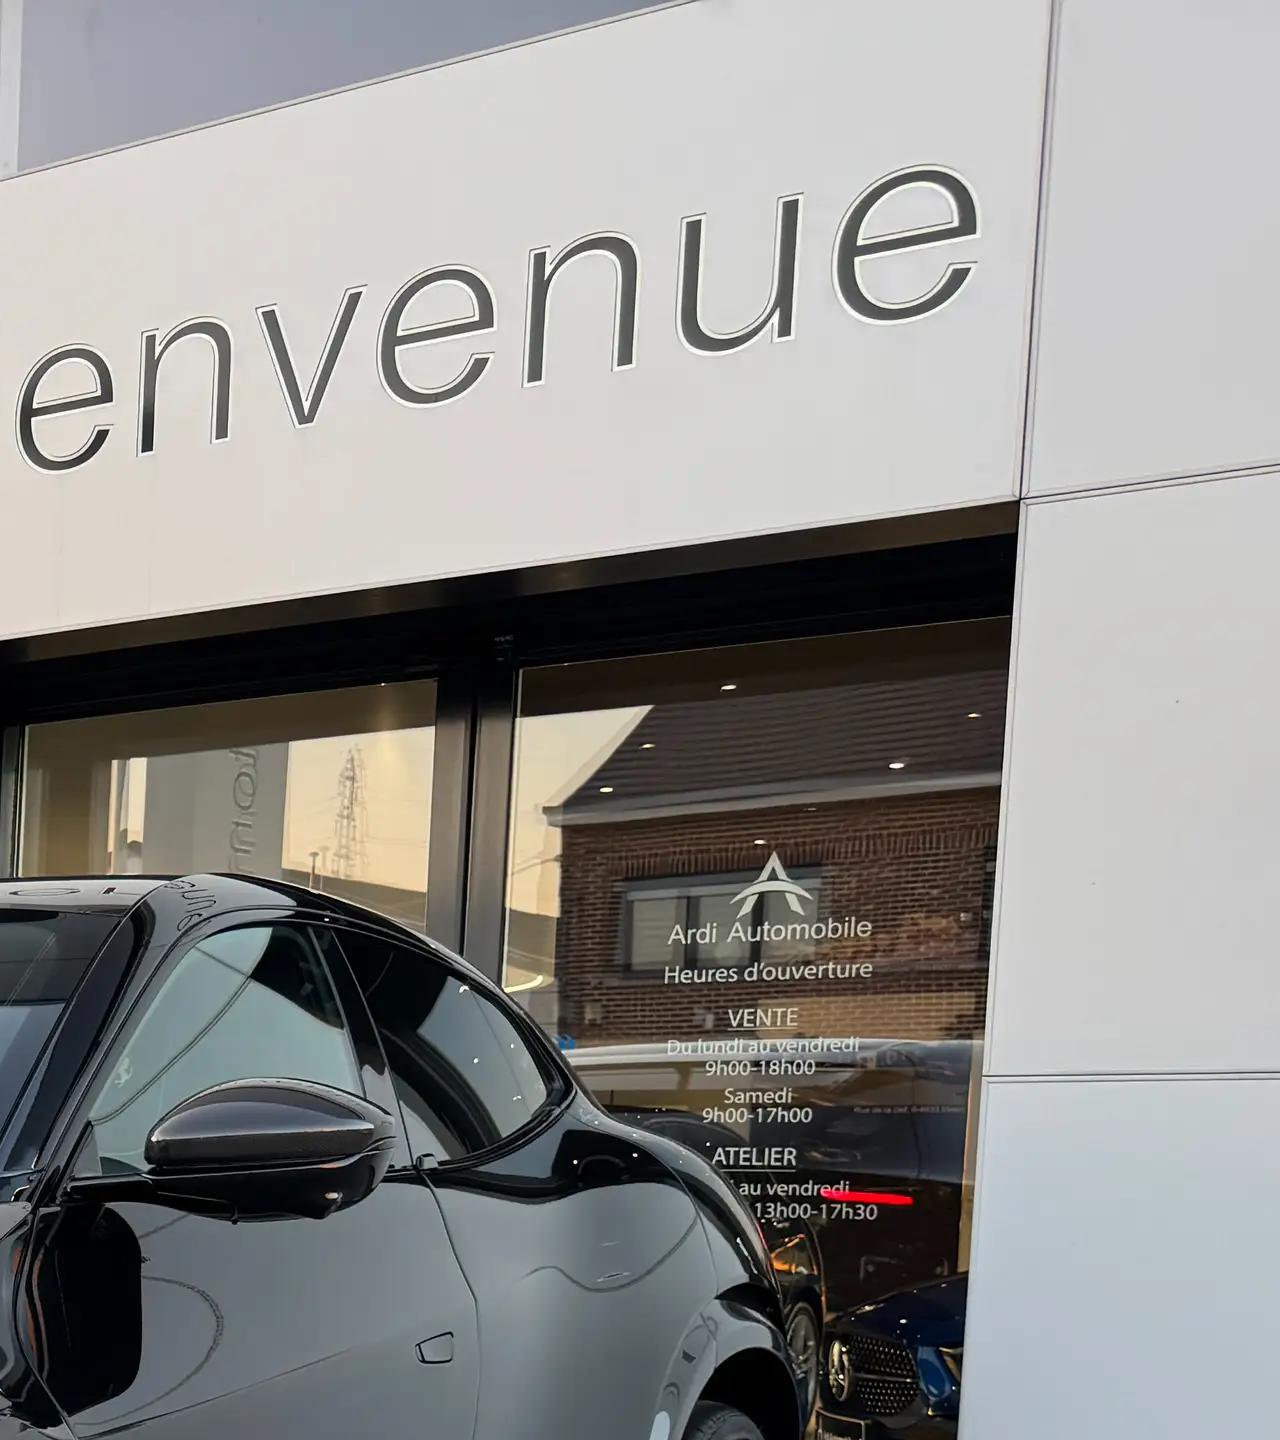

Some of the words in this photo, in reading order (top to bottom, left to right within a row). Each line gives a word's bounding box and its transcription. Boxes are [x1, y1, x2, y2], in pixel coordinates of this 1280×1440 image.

[668, 923, 717, 944] Ardi
[727, 916, 872, 942] Automobile
[664, 965, 738, 984] Heures
[744, 962, 873, 982] d'ouverture
[728, 1008, 799, 1027] VENTE
[667, 1039, 692, 1055] Du
[697, 1038, 742, 1054] lundi
[748, 1041, 770, 1053] au
[776, 1036, 860, 1053] vendredi
[705, 1059, 816, 1076] 9h00-18h00
[724, 1087, 792, 1104] Samedi
[702, 1107, 812, 1124] 9h00-17h00
[712, 1147, 797, 1166] ATELIER
[739, 1182, 761, 1196] au
[767, 1180, 850, 1196] vendredi
[754, 1202, 878, 1220] 13h00-17h30
